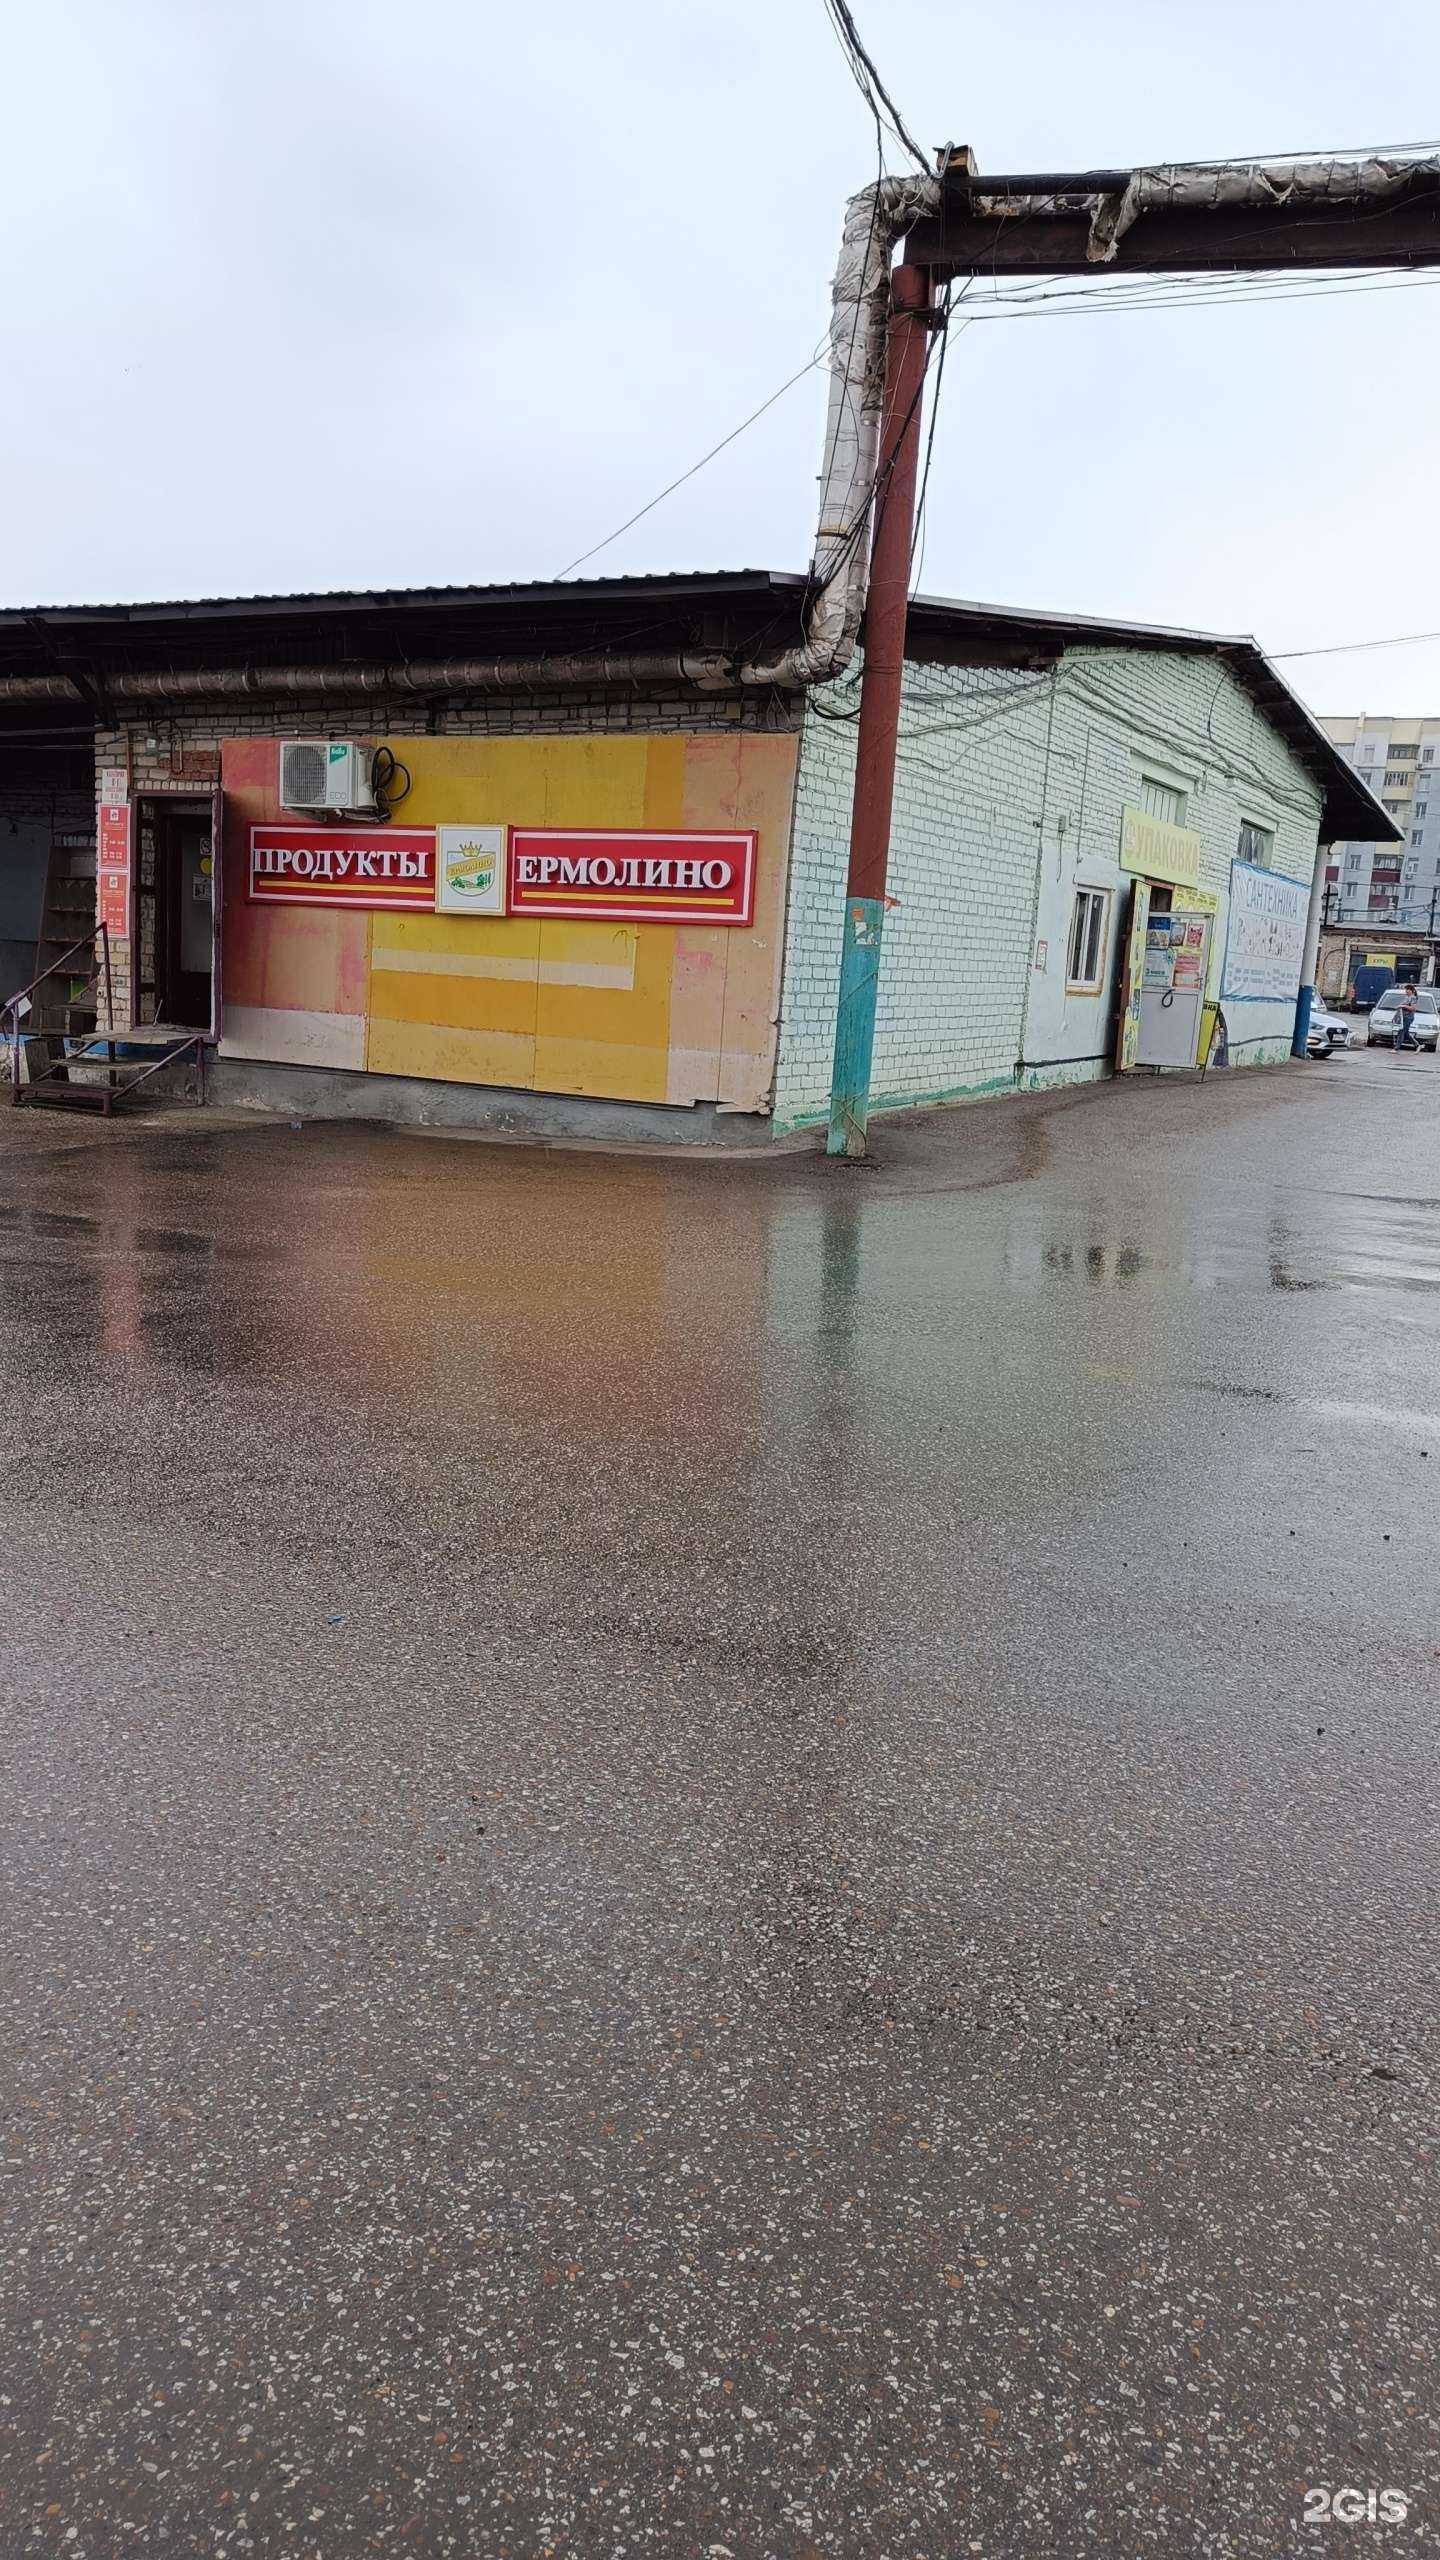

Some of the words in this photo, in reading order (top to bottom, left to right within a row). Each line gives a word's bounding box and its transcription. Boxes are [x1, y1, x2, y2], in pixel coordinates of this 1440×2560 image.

[253, 848, 429, 881] ПРОДУКТЫ
[1135, 823, 1200, 876] УПАКОВКА
[516, 855, 732, 889] ЕРМОЛИНО
[1246, 877, 1298, 919] САНТЕХНИКА
